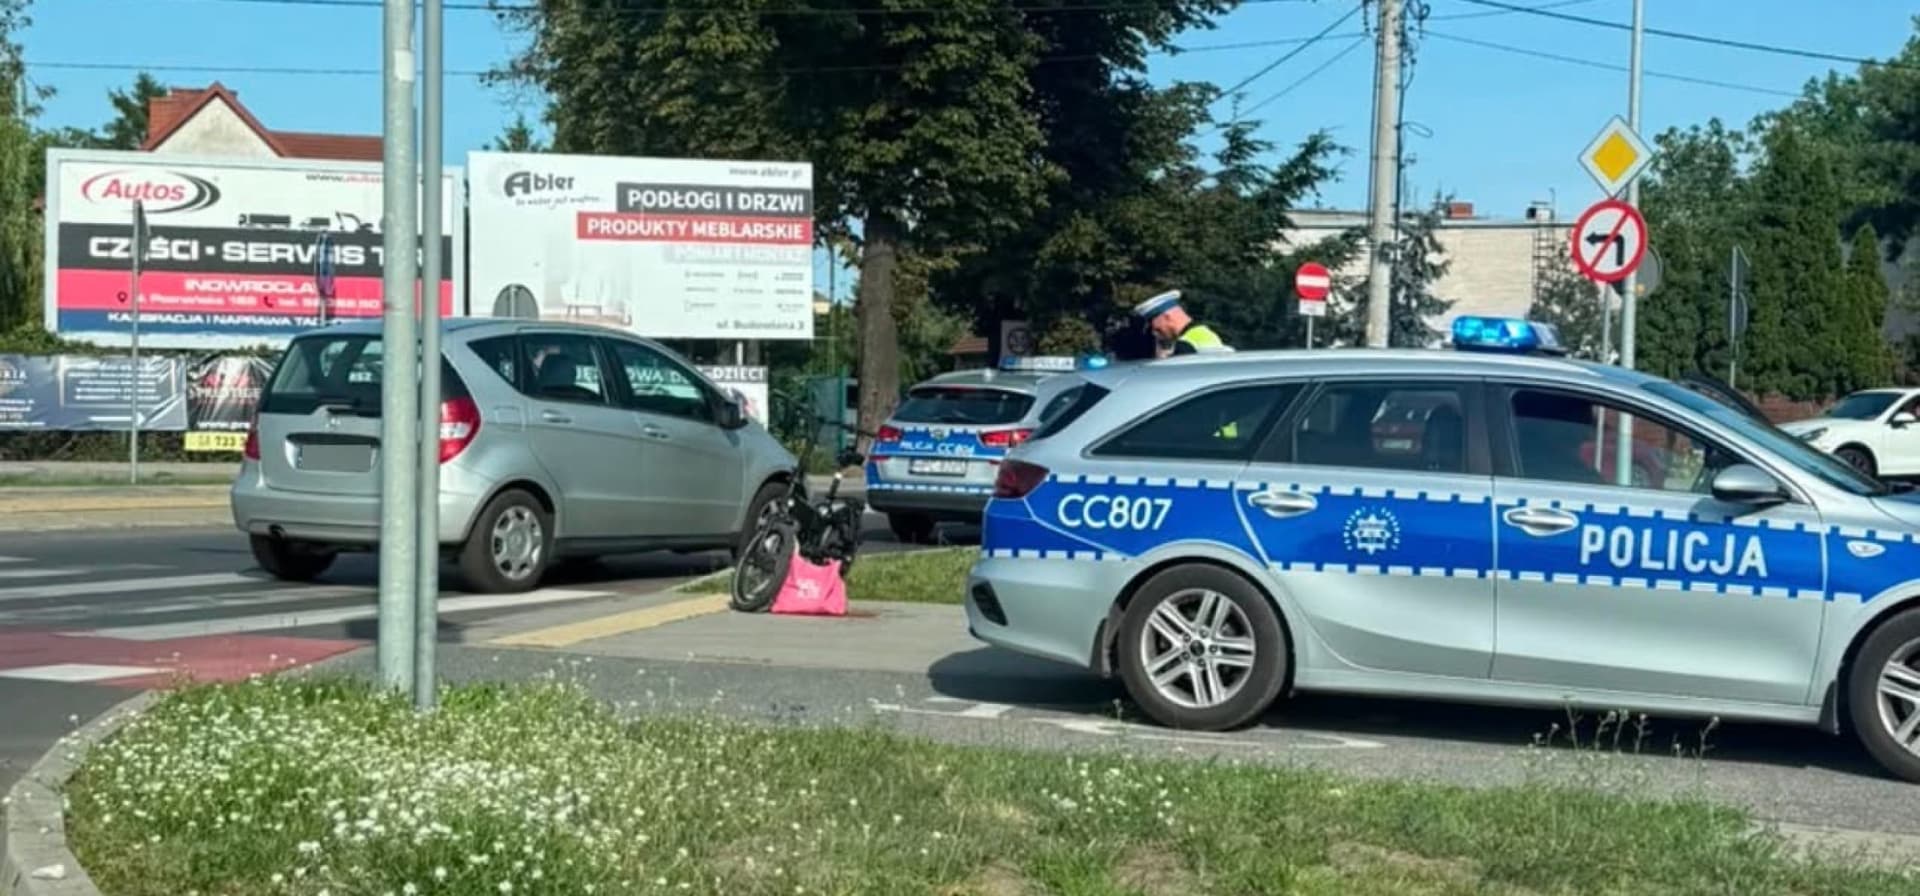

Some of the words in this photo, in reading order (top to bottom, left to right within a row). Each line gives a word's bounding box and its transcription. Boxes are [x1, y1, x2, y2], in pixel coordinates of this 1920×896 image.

[102, 178, 186, 201] Autos
[503, 171, 575, 198] Abler
[628, 189, 721, 210] PODŁOGI
[727, 192, 733, 209] I
[738, 193, 804, 213] DRZWI
[587, 218, 690, 236] PRODUKTY
[693, 221, 802, 240] MEBLARSKIE
[1057, 492, 1174, 531] CC807
[1580, 523, 1768, 578] POLICJA
